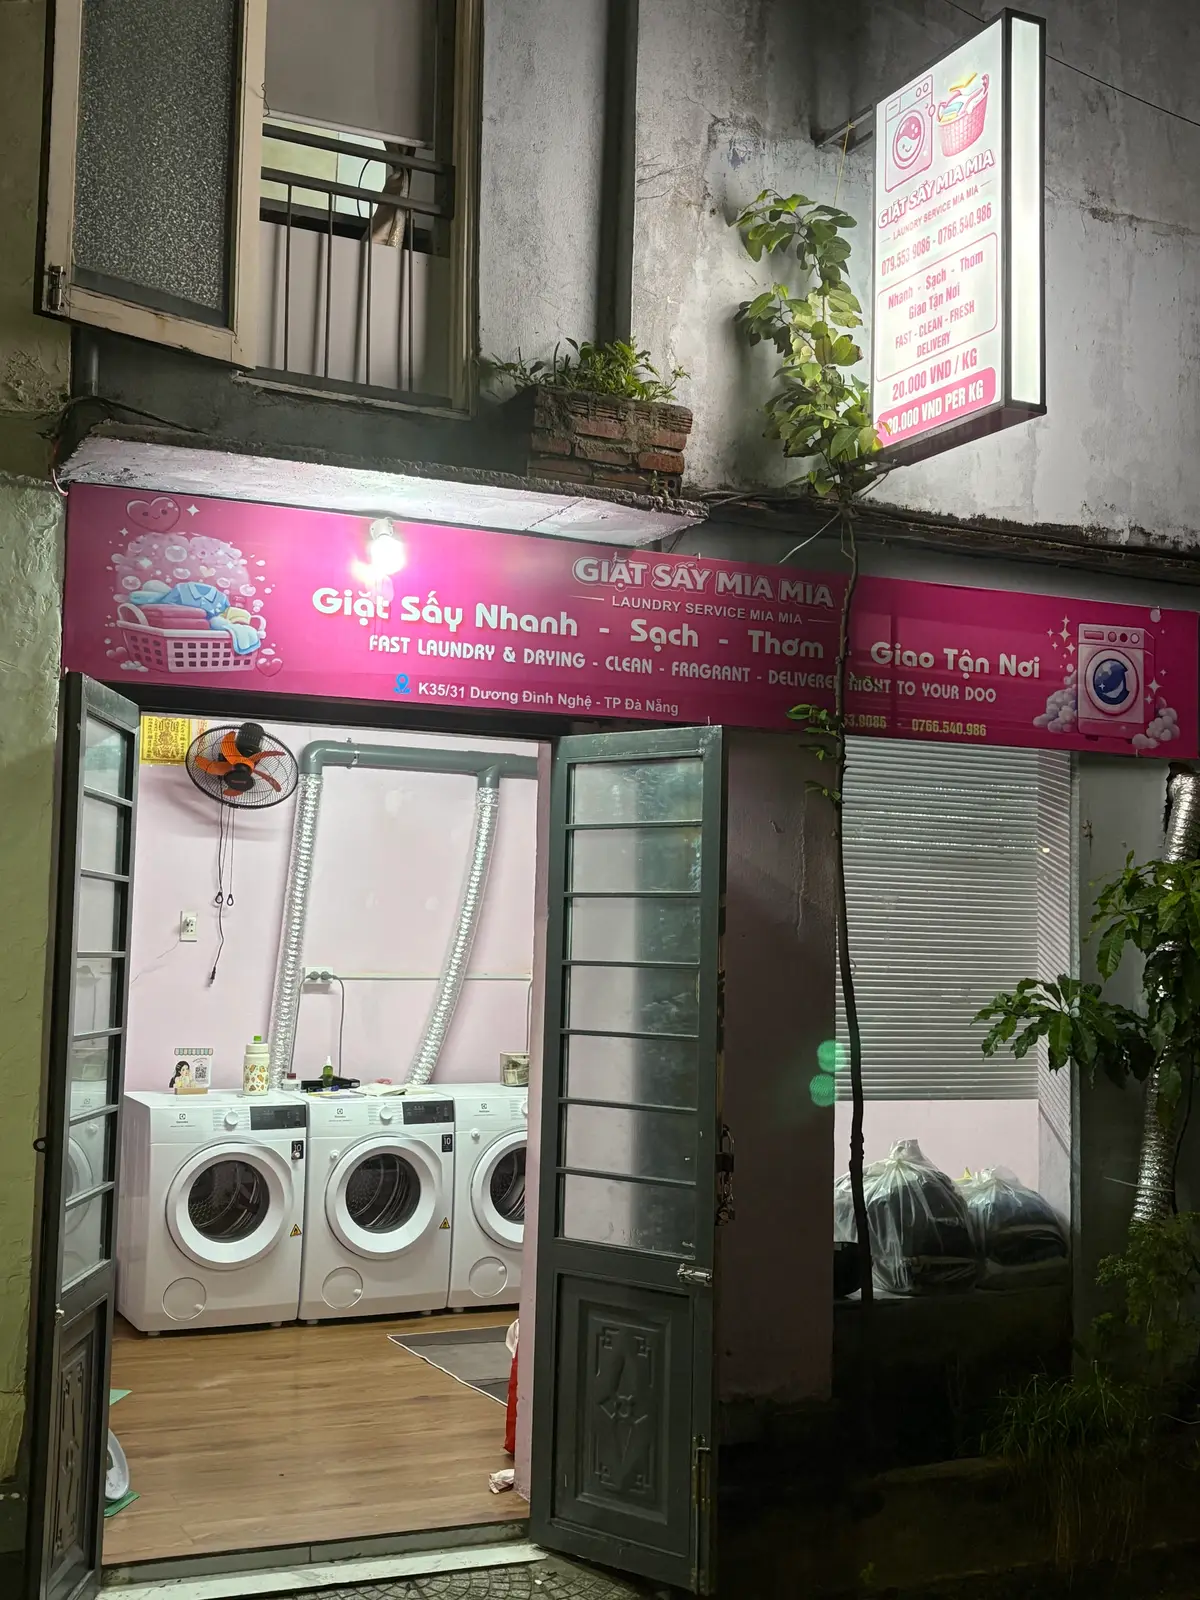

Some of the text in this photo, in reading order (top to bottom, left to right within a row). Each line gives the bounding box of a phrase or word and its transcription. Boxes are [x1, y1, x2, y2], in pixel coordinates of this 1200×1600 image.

[936, 165, 964, 193] MIA
[965, 149, 994, 177] MIA
[892, 184, 979, 240] LAUNDRY SERVICE MIA MIA
[937, 202, 992, 245] 0766.540.986
[888, 286, 914, 310] Nhanh
[925, 269, 947, 291] Sạch
[908, 303, 927, 320] Giao
[928, 294, 944, 312] Tận
[895, 330, 912, 349] FAST
[918, 316, 943, 337] CLEAN
[949, 300, 975, 323] FRESH
[916, 330, 951, 358] DELIVERY
[892, 347, 978, 402] 20.000 VND / KG
[921, 396, 942, 422] VND
[944, 387, 966, 413] PER
[968, 380, 984, 403] KG
[574, 558, 834, 608] GIẶT SẤY MIA MIA
[612, 595, 803, 625] LAUNDRY SERVICE MIA MIA
[312, 587, 390, 626] Giặt
[400, 590, 463, 633] Sấy
[475, 602, 578, 637] Nhanh
[630, 618, 699, 652] Sạch
[748, 629, 824, 659] Thơm
[870, 641, 935, 669] Giao
[943, 648, 989, 680] Tận
[999, 653, 1040, 679] Nơi
[368, 634, 411, 654] FAST
[417, 638, 495, 661] LAUNDRY
[503, 646, 516, 663] &
[523, 648, 586, 669] DRYING
[605, 655, 652, 675] CLEAN
[671, 661, 750, 683] FRAGRANT
[768, 669, 837, 690] DELIVERE
[897, 681, 916, 696] TO
[921, 683, 960, 700] YOUR
[964, 686, 997, 703] DOO
[418, 682, 466, 700] K35/31
[470, 686, 519, 705] Dương
[557, 693, 592, 710] Nghệ
[604, 697, 622, 709] TP
[624, 697, 642, 711] Đà
[645, 697, 679, 717] Nẵng
[911, 718, 987, 737] 0766.540.986
